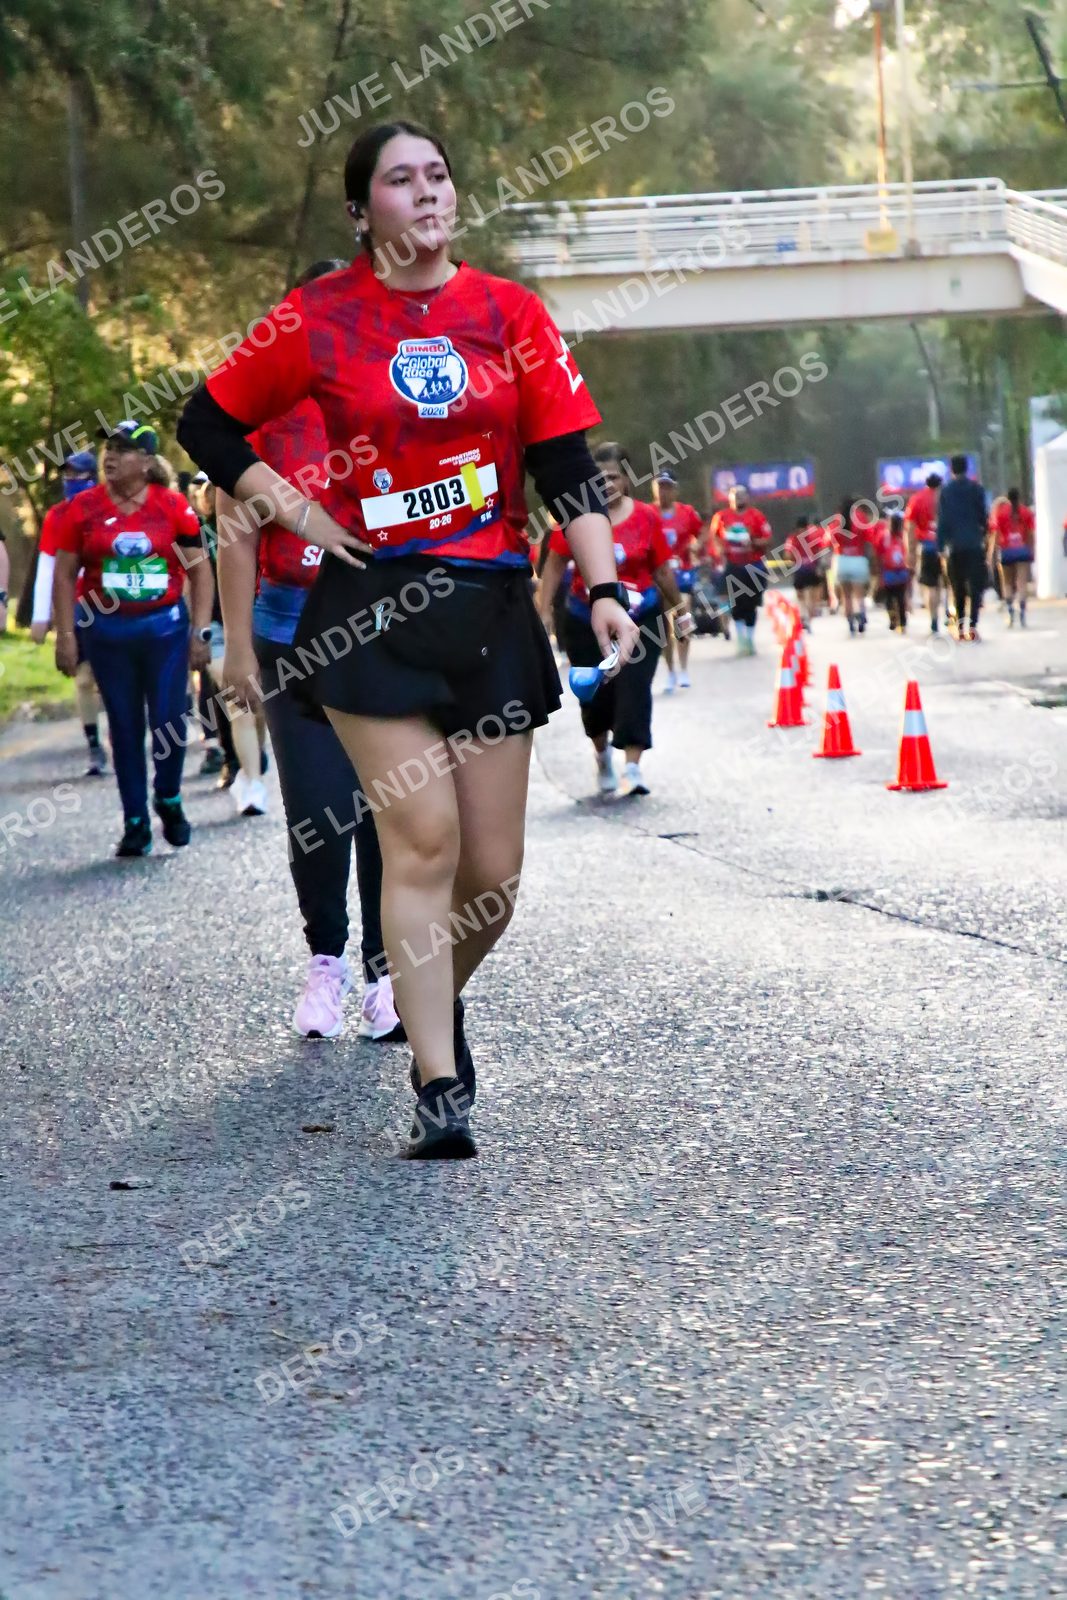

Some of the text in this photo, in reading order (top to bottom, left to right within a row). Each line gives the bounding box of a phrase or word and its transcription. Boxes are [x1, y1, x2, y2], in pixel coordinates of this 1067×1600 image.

[406, 344, 445, 352] BIMBO
[408, 356, 446, 369] Global
[402, 366, 434, 378] Race
[421, 407, 445, 416] 2026
[403, 478, 466, 519] 2803
[429, 514, 452, 530] 20-26
